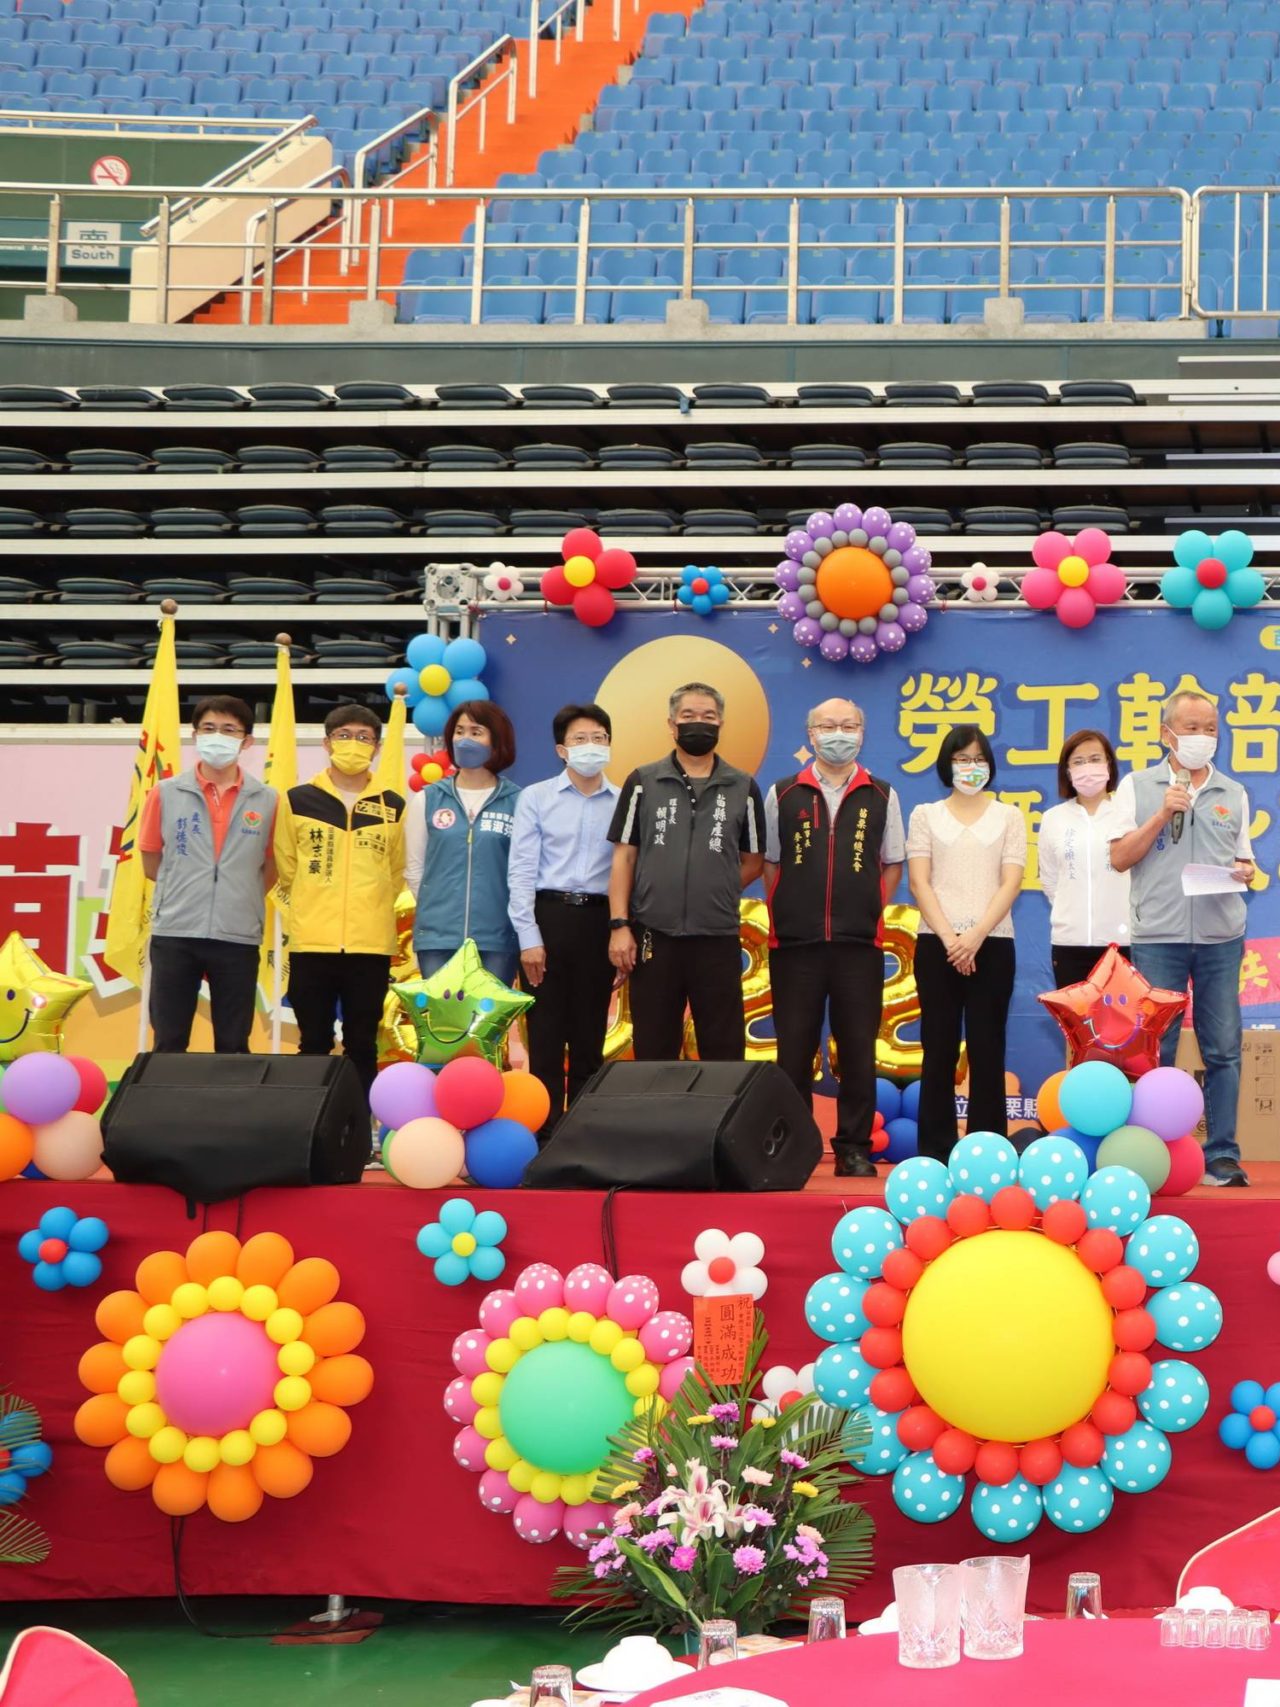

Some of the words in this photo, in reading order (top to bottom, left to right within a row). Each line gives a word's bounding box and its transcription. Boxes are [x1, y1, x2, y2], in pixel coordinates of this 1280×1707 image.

[71, 249, 115, 260] South
[308, 828, 325, 875] 林志豪
[720, 1303, 738, 1381] 圓滿成功
